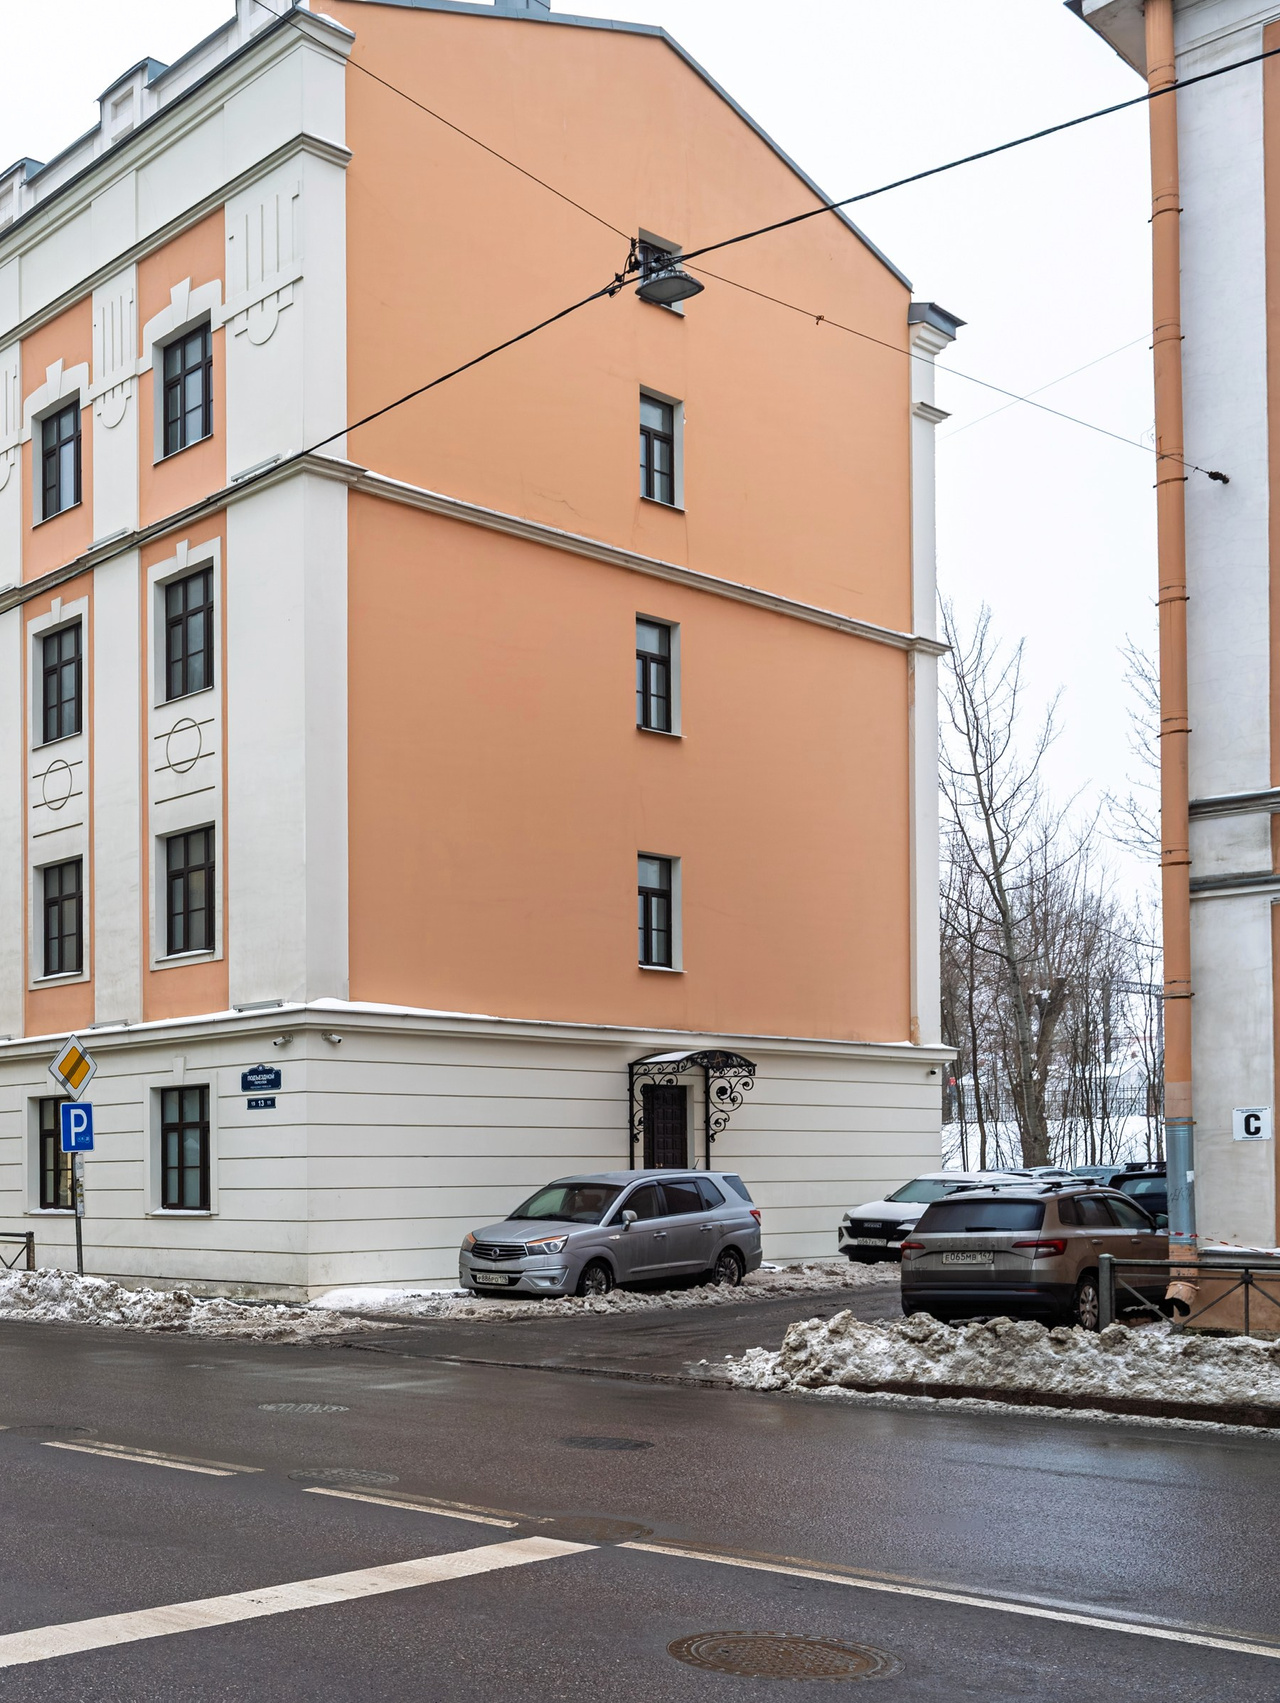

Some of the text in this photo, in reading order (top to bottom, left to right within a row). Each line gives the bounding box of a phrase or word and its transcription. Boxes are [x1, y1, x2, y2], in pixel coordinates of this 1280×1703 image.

[258, 1099, 265, 1107] 13
[70, 1108, 88, 1146] P
[1244, 1113, 1261, 1136] C
